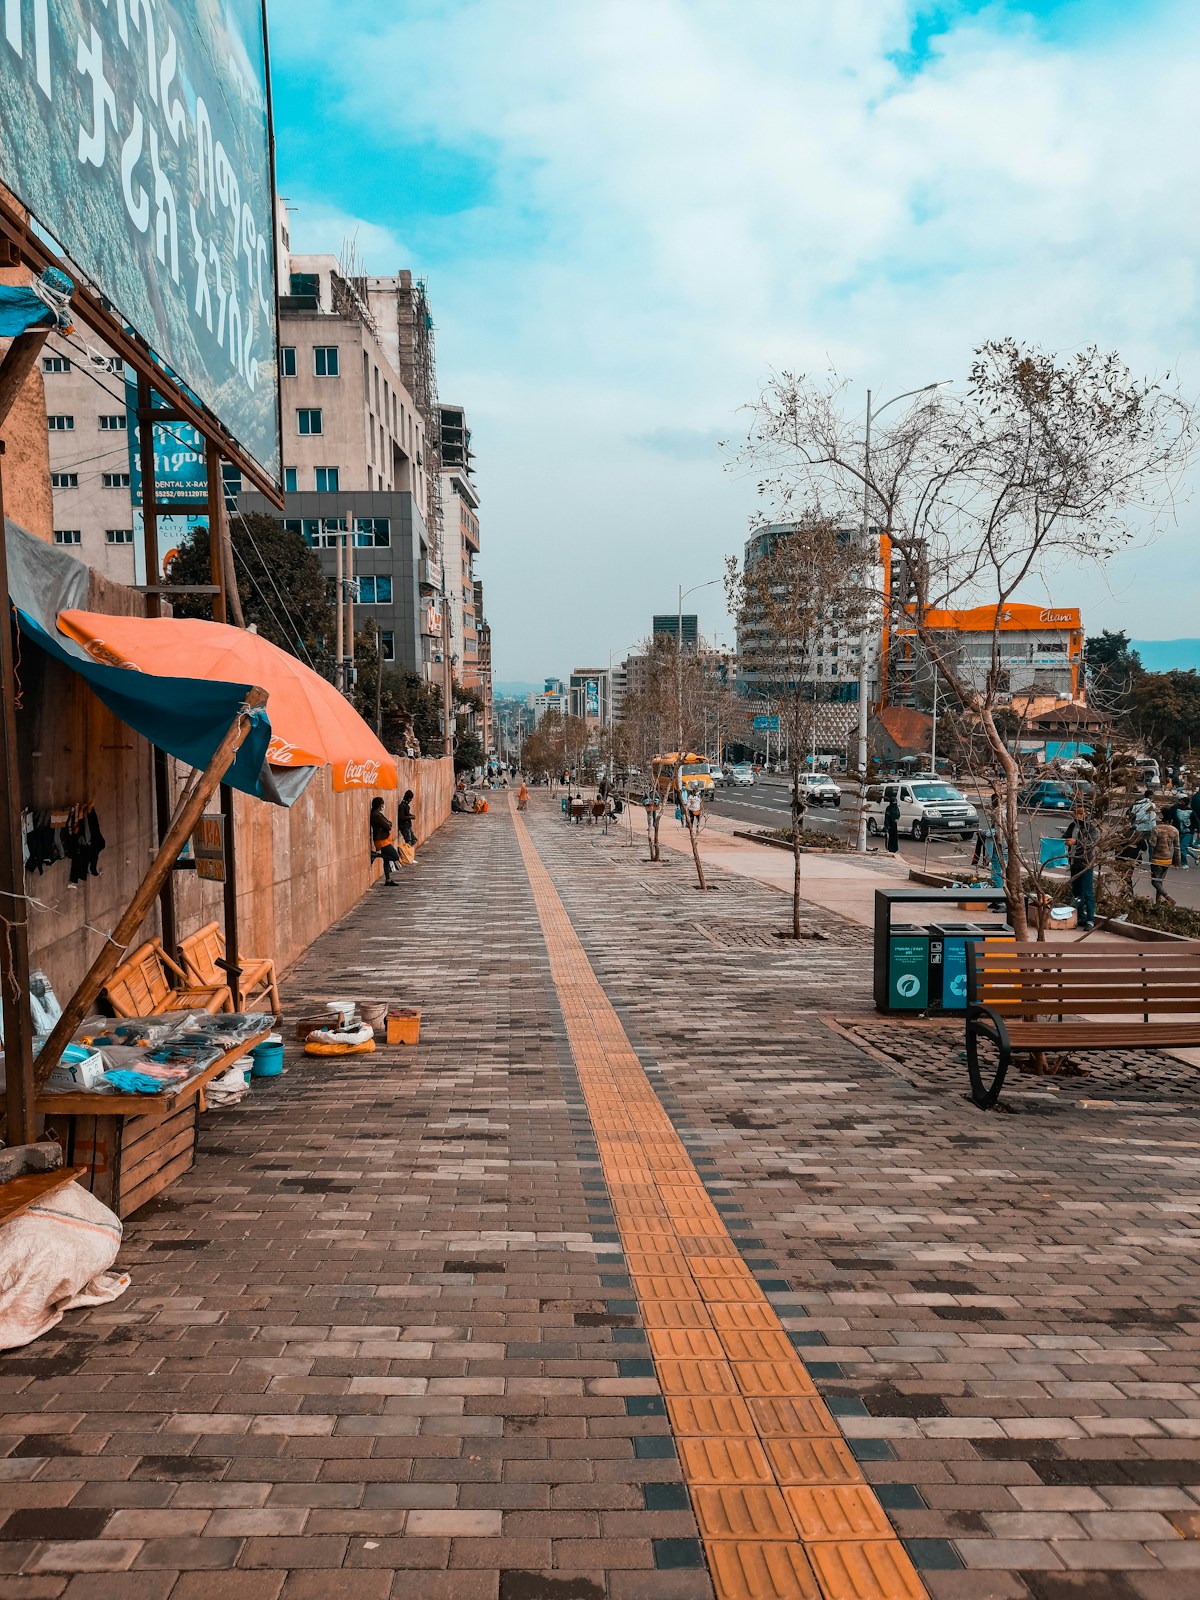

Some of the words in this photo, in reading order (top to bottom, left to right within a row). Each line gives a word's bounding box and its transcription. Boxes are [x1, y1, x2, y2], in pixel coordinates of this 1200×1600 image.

[77, 22, 180, 286] ታሪክ
[188, 202, 260, 394] እንስራ
[1039, 609, 1072, 622] Eliana
